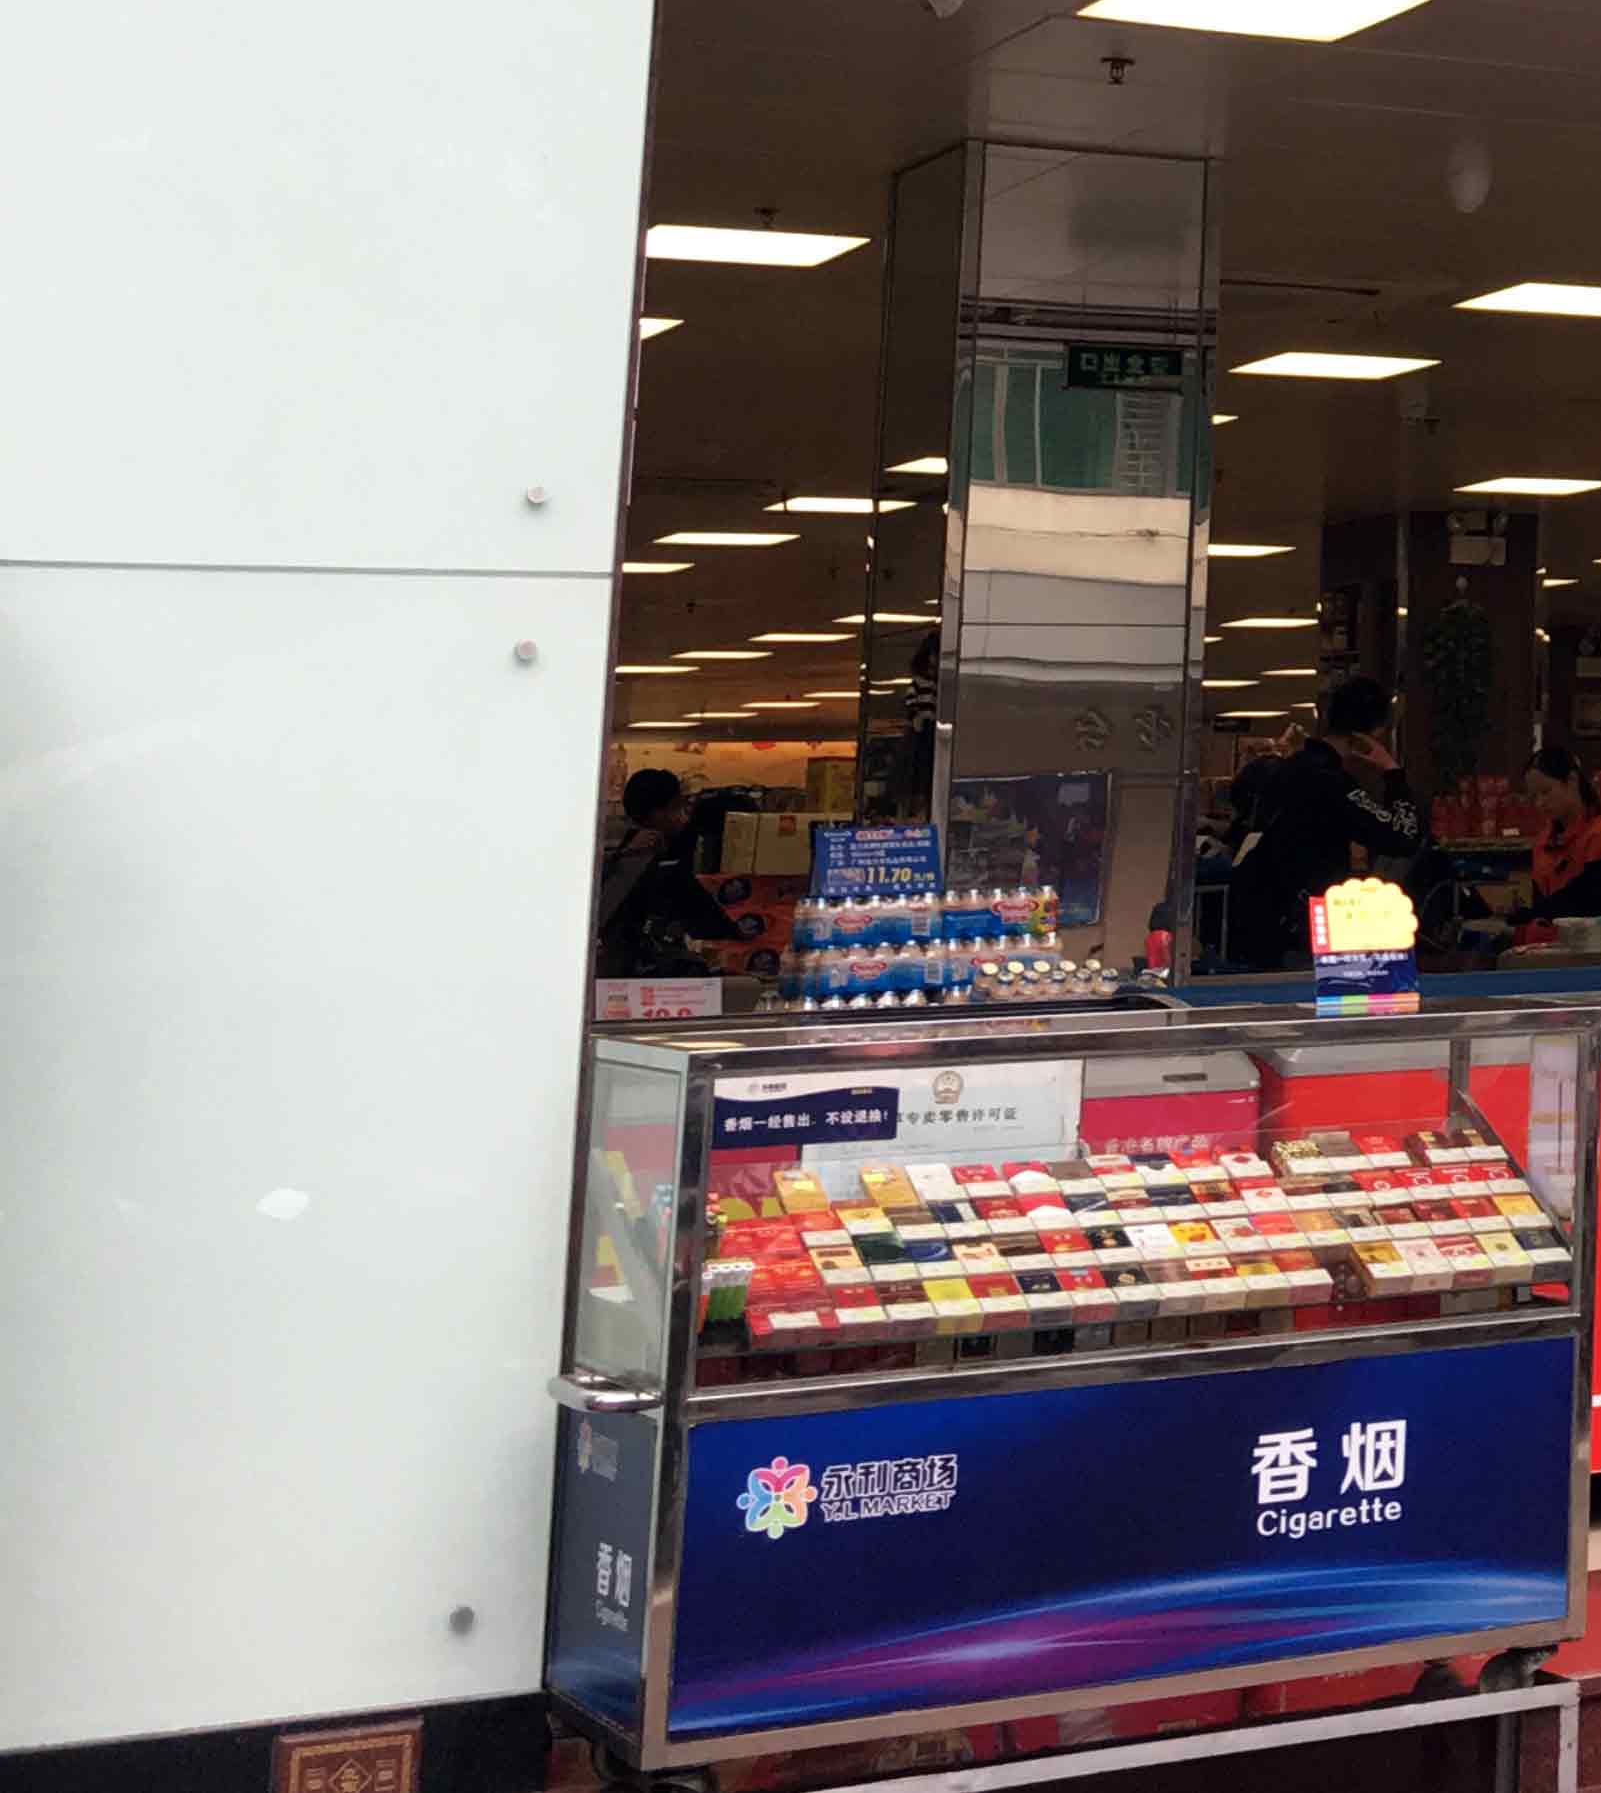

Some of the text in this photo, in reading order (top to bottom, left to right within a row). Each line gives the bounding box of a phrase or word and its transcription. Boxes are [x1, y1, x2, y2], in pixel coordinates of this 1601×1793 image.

[821, 1454, 958, 1502] 永利商场
[1250, 1418, 1408, 1505] 香烟
[860, 1490, 957, 1519] MARKET
[1255, 1497, 1403, 1540] Cigarette
